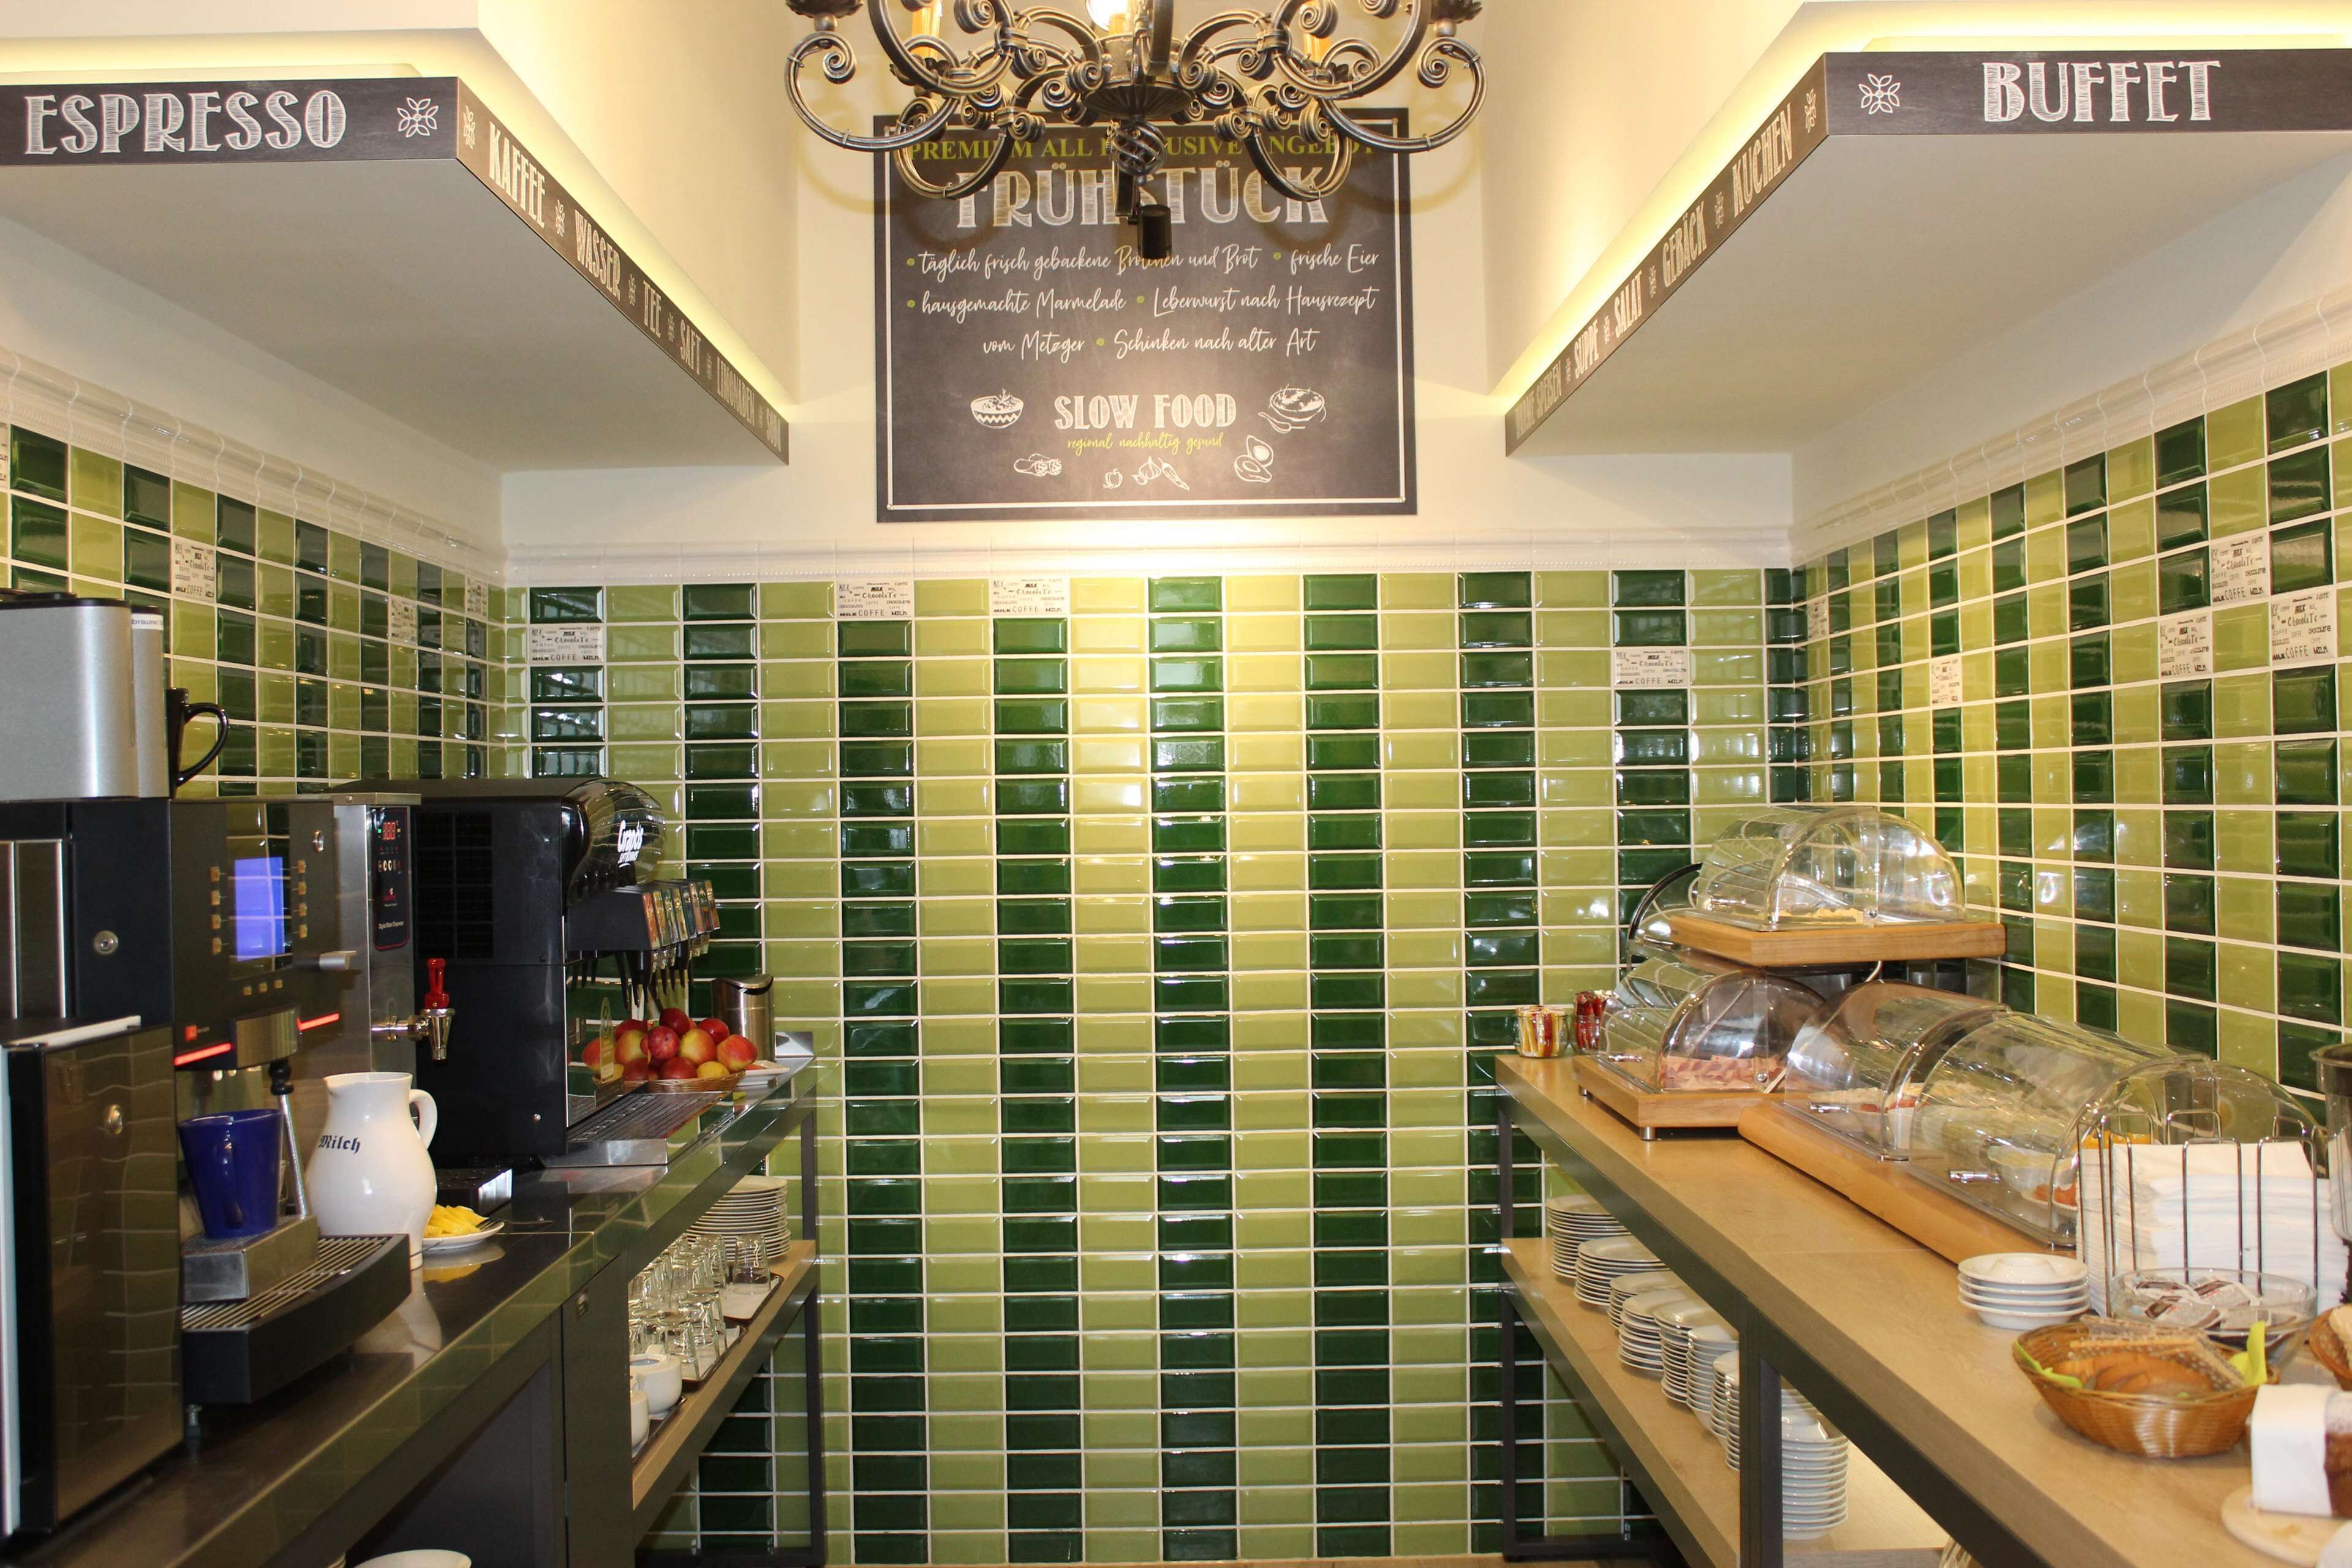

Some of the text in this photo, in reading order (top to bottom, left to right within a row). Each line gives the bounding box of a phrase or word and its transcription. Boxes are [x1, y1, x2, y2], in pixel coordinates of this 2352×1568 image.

[1981, 60, 2221, 123] BUFFET
[24, 89, 347, 155] ESPRESSO
[910, 138, 1033, 160] PREMIM
[1042, 138, 1093, 157] ALL
[489, 121, 546, 229] KAFFEE
[575, 209, 621, 301] WASSER
[643, 279, 662, 339] TEE
[680, 318, 702, 376] SAFT
[717, 356, 755, 427] LIMONADEN
[918, 248, 980, 282] täglich
[984, 246, 1030, 279] frisch
[1033, 246, 1112, 281] gebackene
[1188, 246, 1220, 268] und
[1222, 244, 1262, 275] Brot
[1291, 243, 1343, 275] frische
[1348, 244, 1379, 273] Eier
[1536, 360, 1562, 418] SPEISEN
[1574, 319, 1600, 379] SUPPE
[1613, 270, 1644, 339] SALAT
[1662, 200, 1708, 288] GEBÄCK
[1732, 102, 1795, 219] KUCHEN
[922, 285, 1381, 324] hausgemachte Marmelade Leberwurst nach Hausrezept
[983, 326, 1321, 364] vom Metzger Schinken nach alter Art
[1054, 393, 1237, 430] SLOW FOOD
[1068, 431, 1224, 456] regional nachhaltig gesund
[2285, 645, 2309, 659] COFFE
[318, 1134, 361, 1155] Milch
